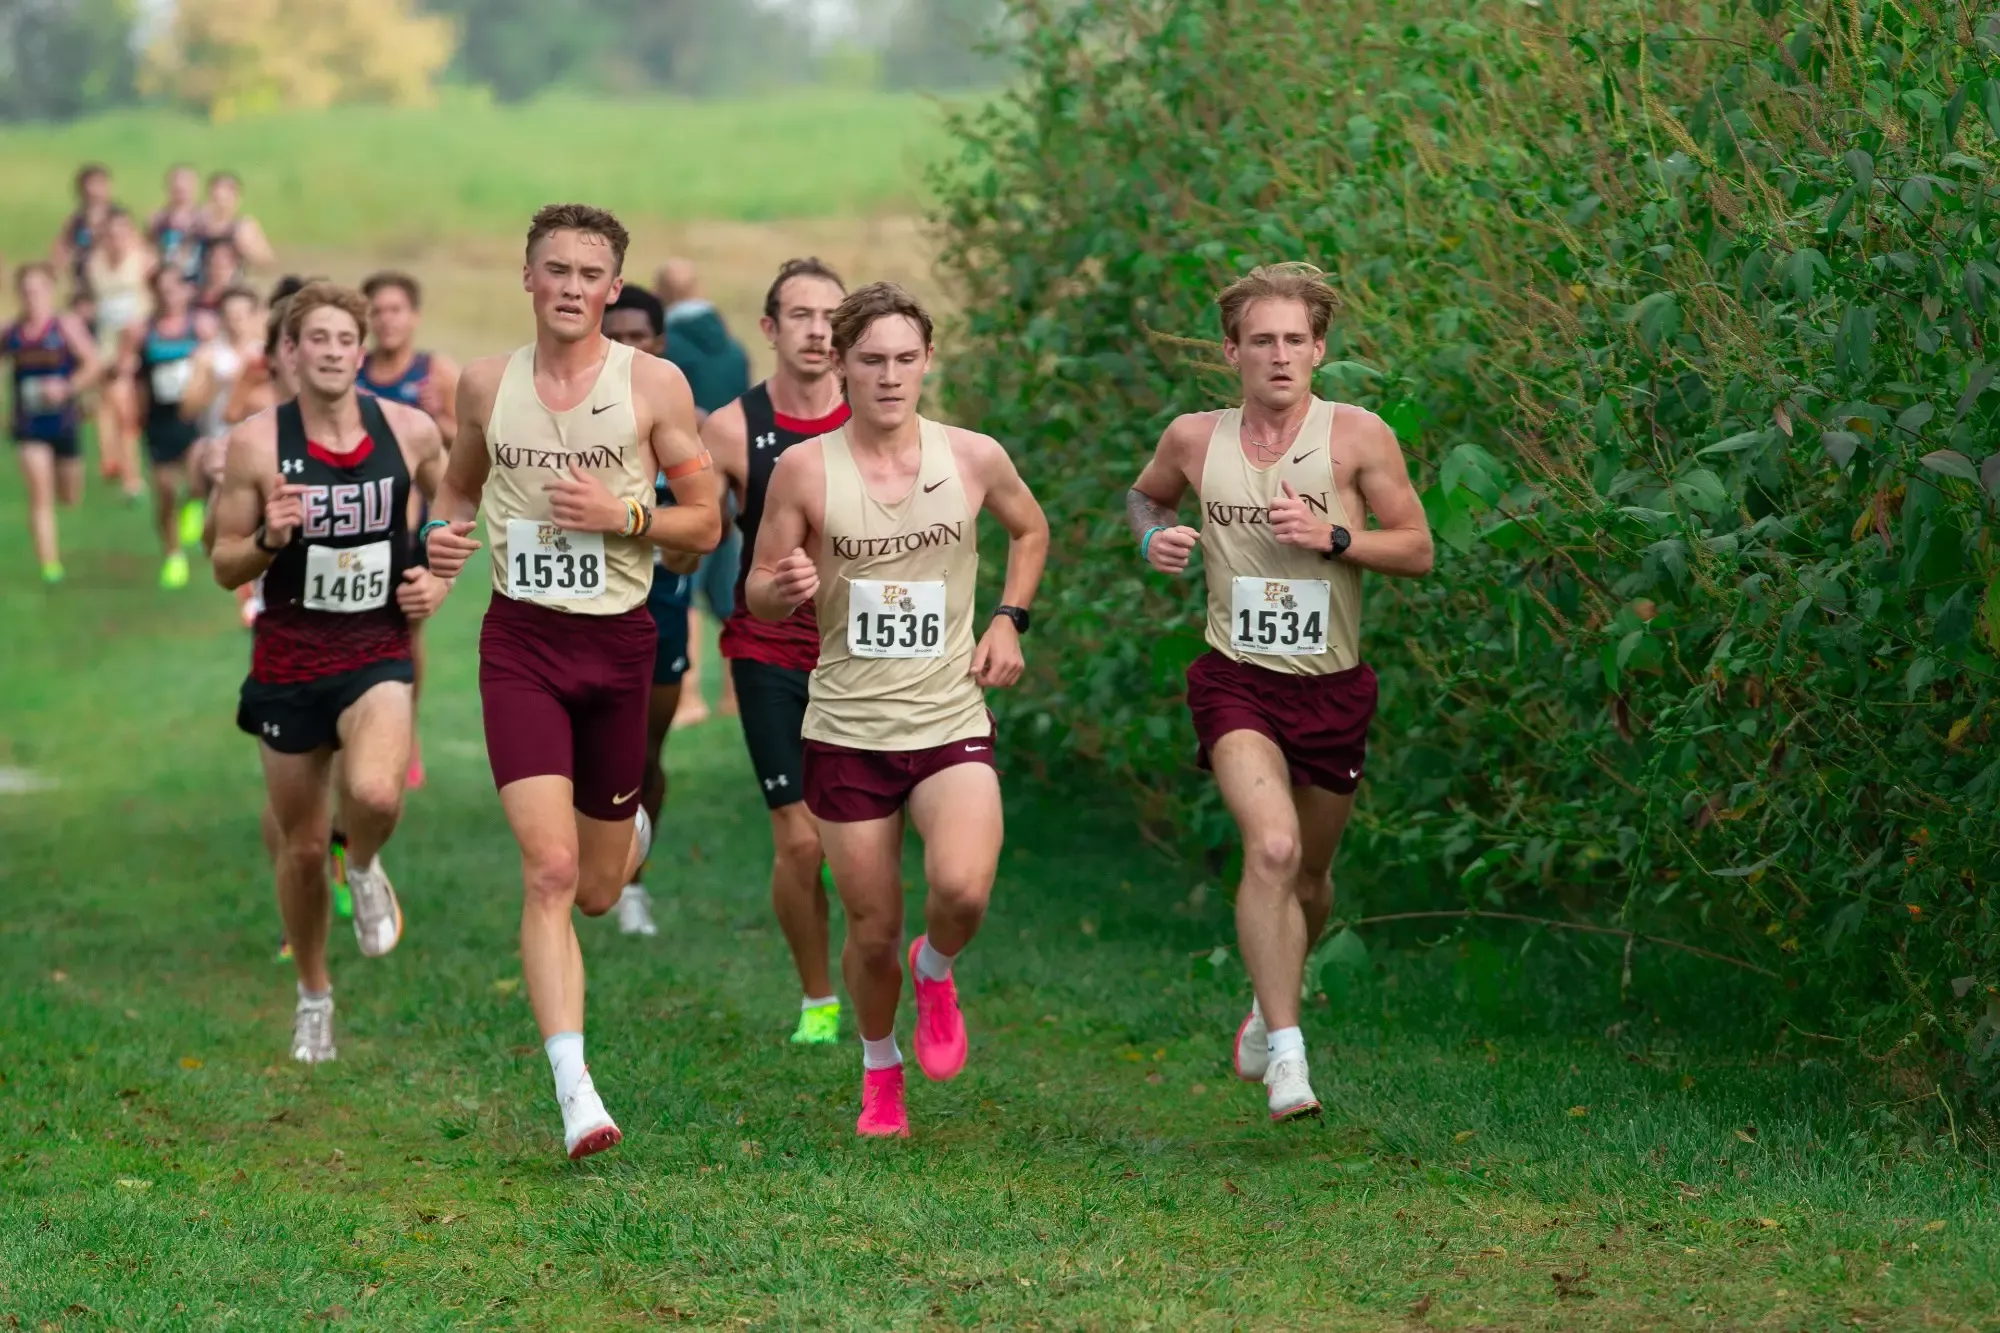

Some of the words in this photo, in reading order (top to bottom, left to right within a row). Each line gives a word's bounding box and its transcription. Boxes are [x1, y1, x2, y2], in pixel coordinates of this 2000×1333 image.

[494, 443, 628, 470] KUTZTOWN
[301, 476, 395, 538] ESU
[1206, 491, 1330, 526] KUTZTN
[831, 520, 964, 560] KUTZTOWN
[312, 569, 384, 602] 1465
[515, 552, 599, 588] 1538
[855, 612, 939, 647] 1536
[1238, 609, 1323, 645] 1534
